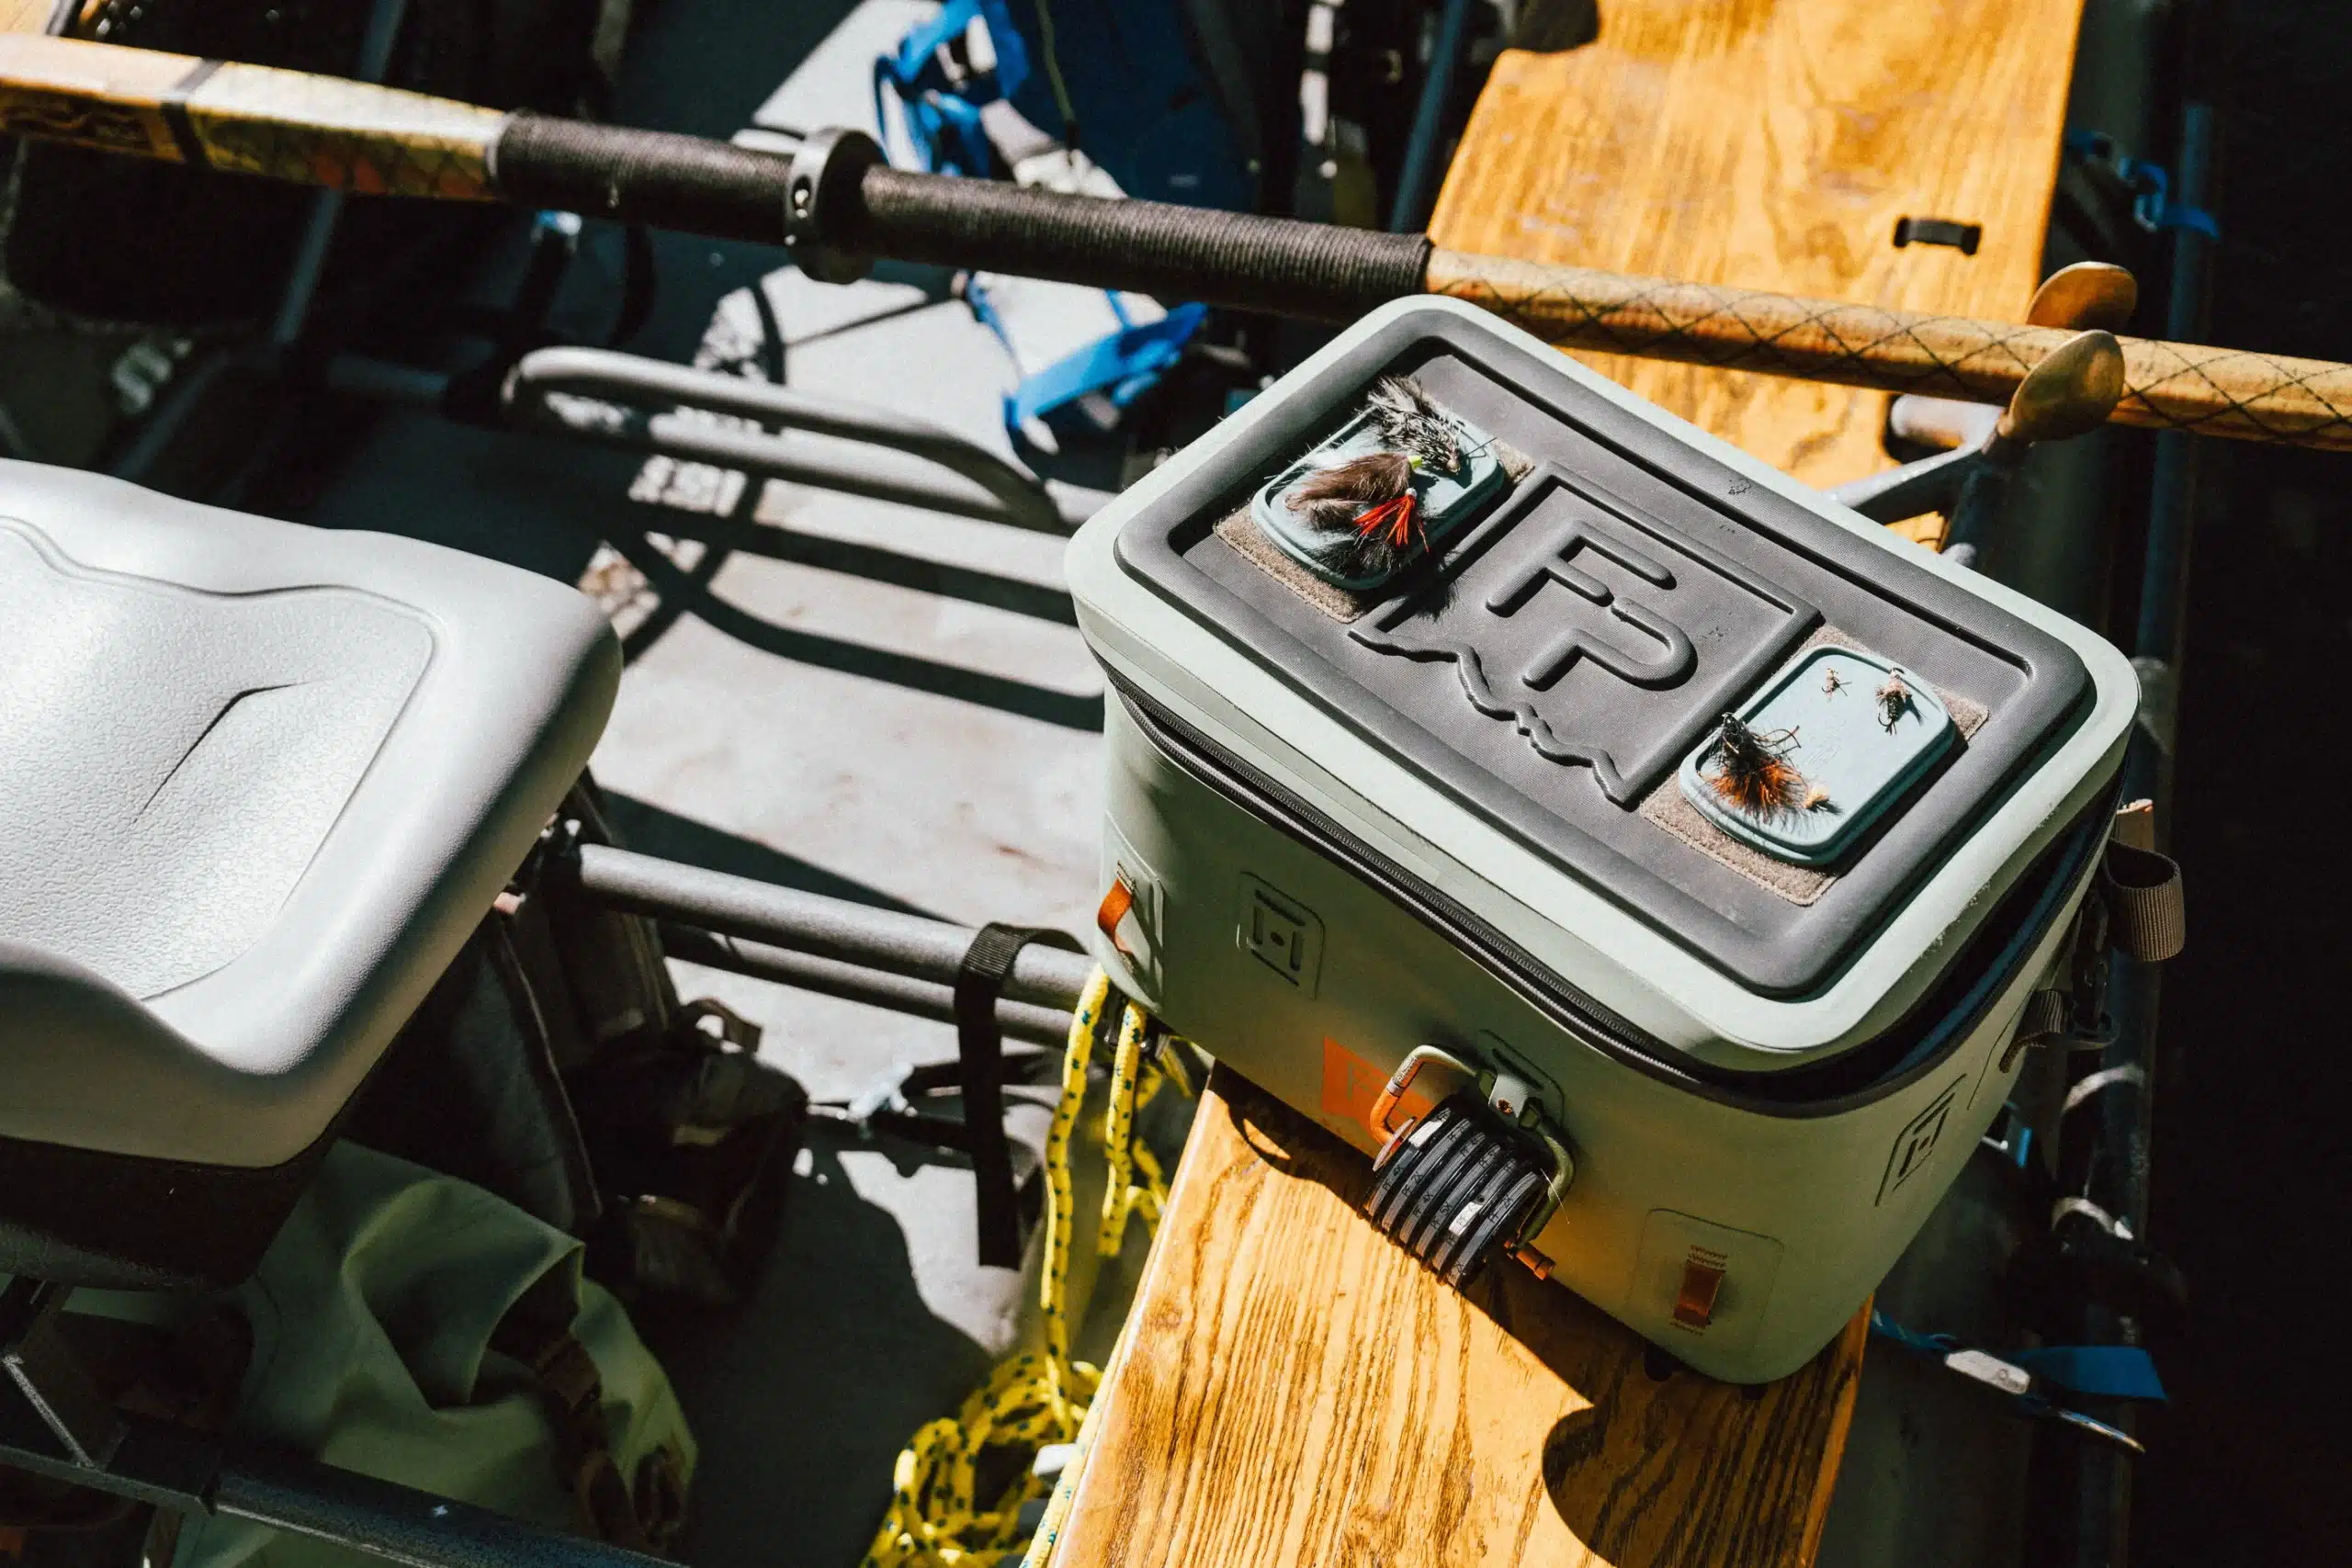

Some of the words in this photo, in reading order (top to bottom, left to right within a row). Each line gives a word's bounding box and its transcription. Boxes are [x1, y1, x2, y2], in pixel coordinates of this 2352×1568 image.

[1400, 1184, 1412, 1197] PF
[1420, 1190, 1433, 1203] 4X
[1430, 1215, 1442, 1228] PF
[1440, 1201, 1453, 1215] 5X
